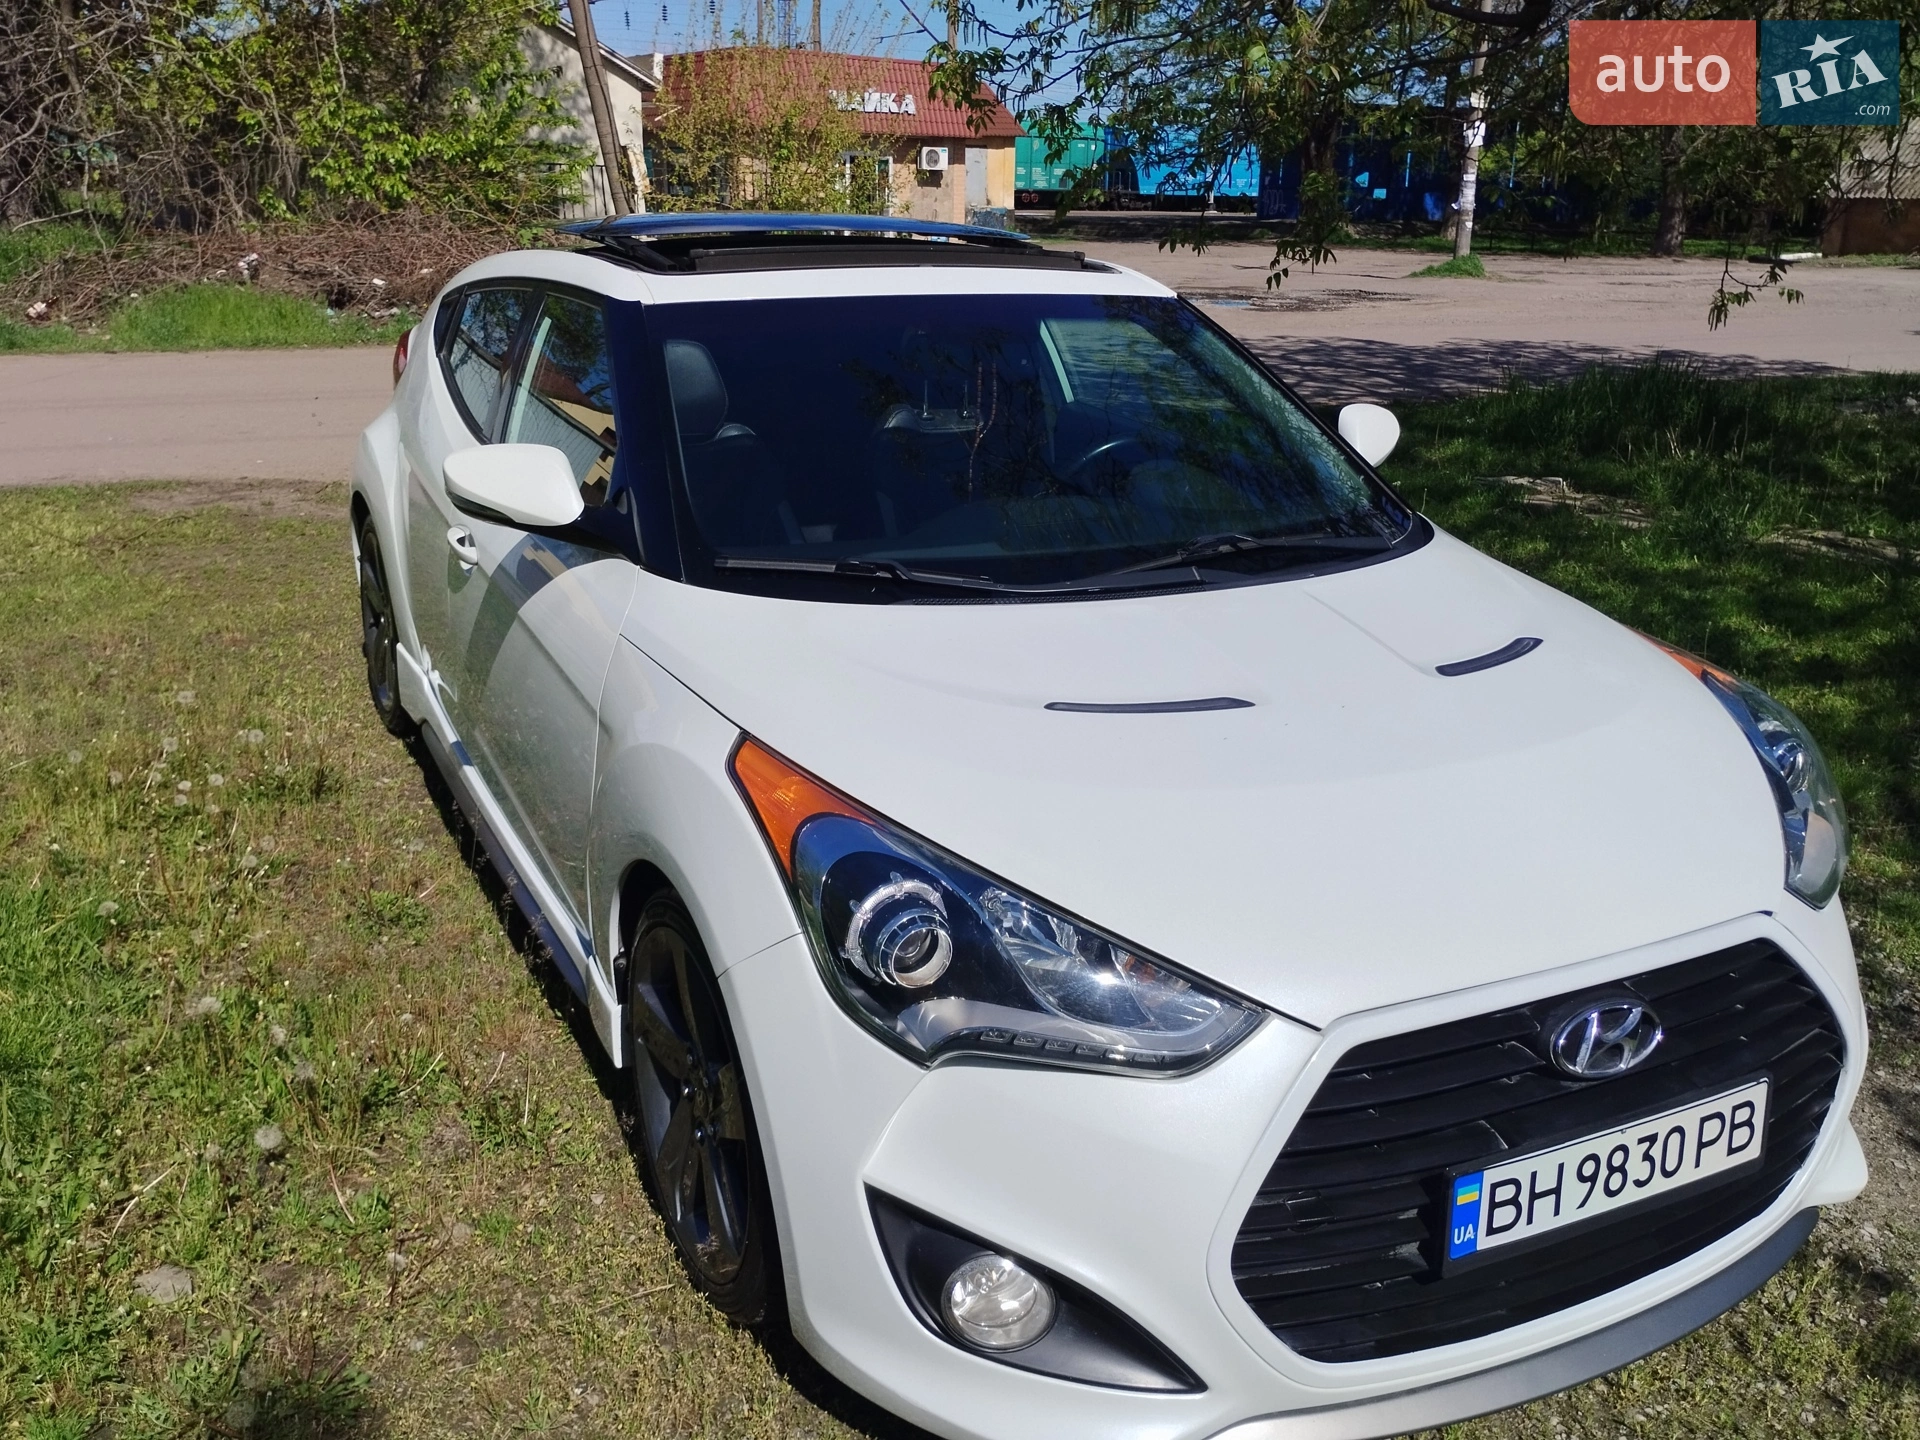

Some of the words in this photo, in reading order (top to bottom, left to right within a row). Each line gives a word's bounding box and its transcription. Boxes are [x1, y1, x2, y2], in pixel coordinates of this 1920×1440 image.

[1485, 1162, 1565, 1238] BH
[1576, 1125, 1687, 1210] 9830
[1693, 1100, 1756, 1169] PB
[1454, 1223, 1477, 1245] UA
